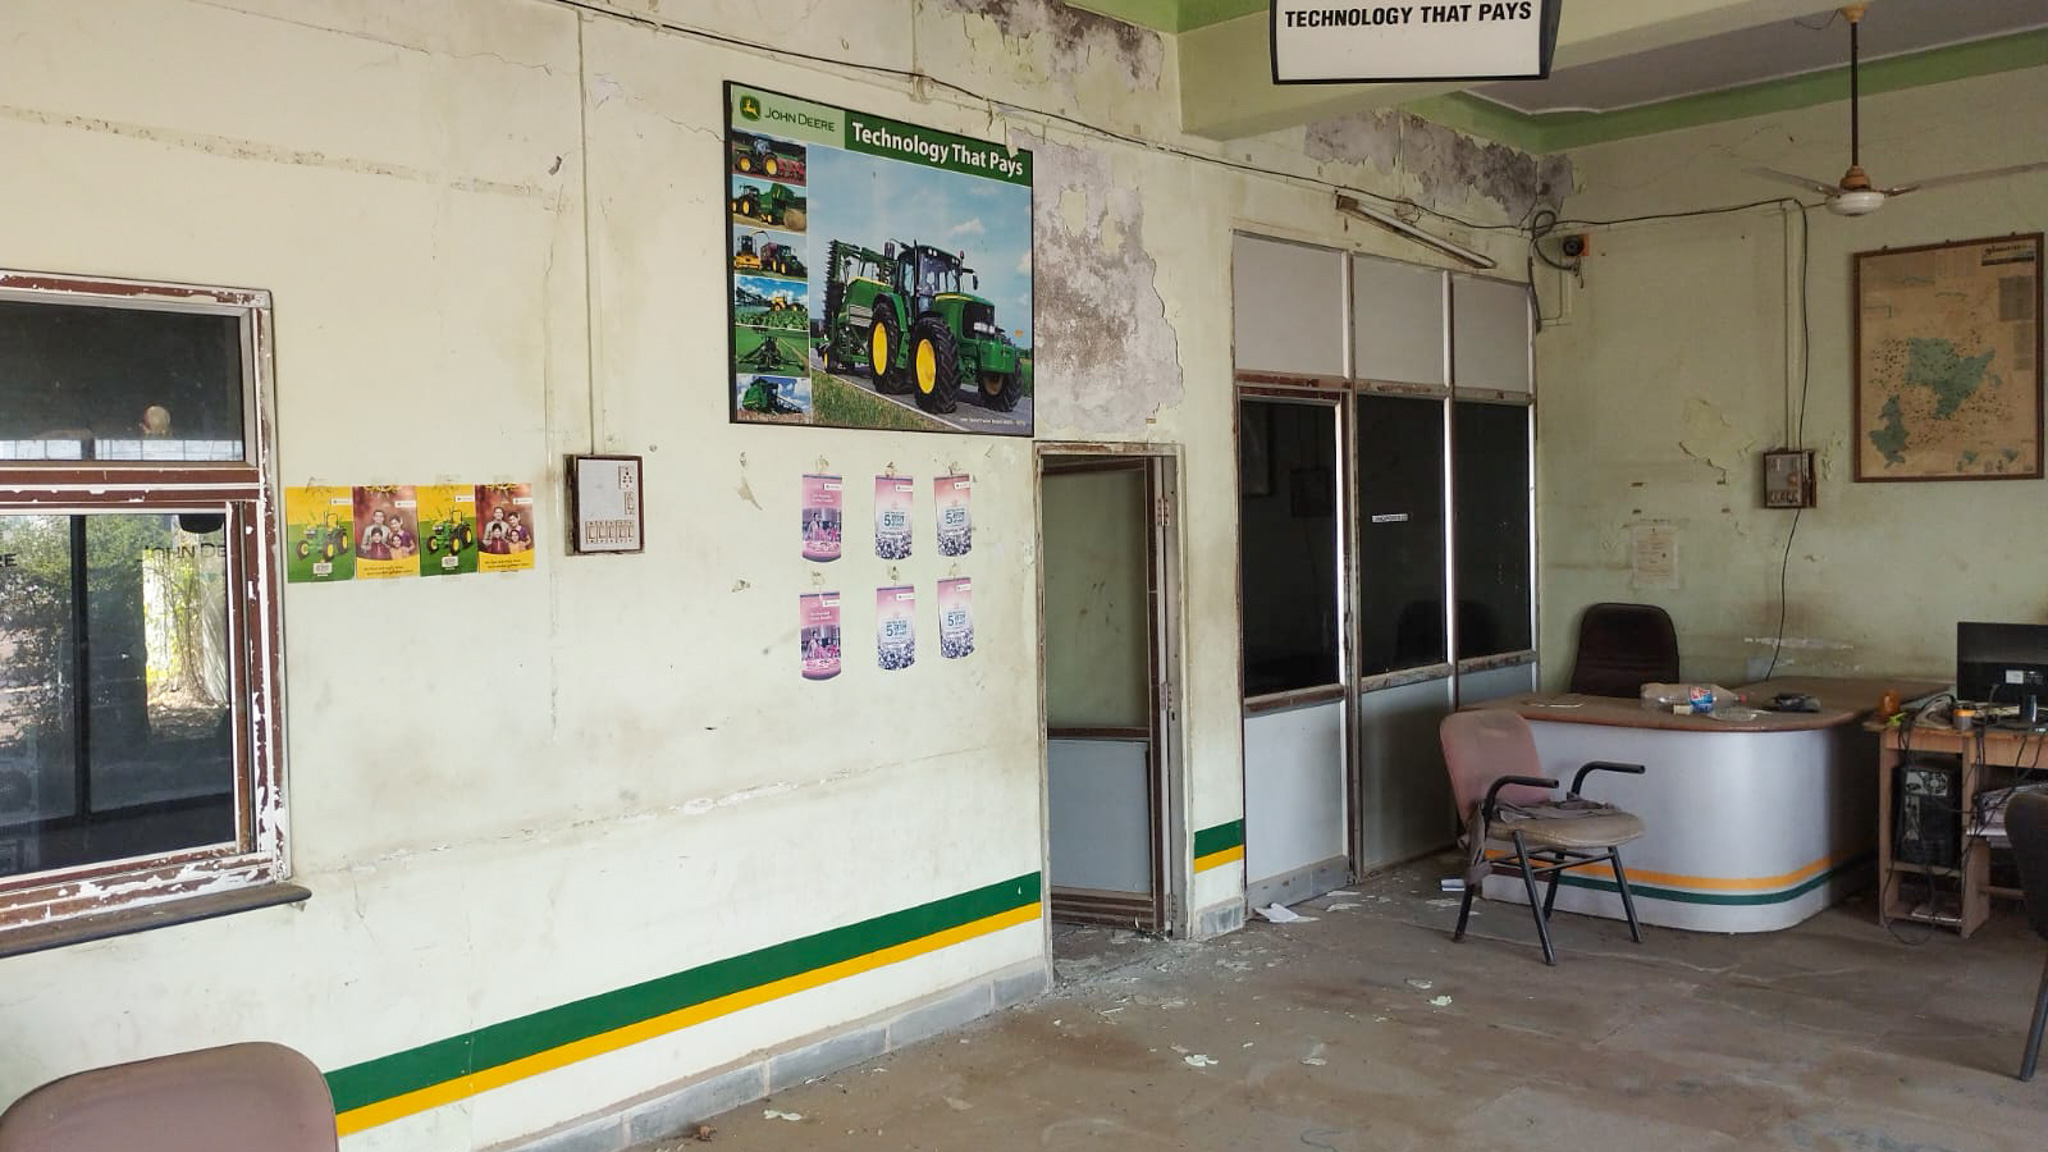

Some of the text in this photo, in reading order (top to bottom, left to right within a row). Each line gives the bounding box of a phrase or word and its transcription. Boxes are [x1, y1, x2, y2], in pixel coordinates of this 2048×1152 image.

[1285, 1, 1532, 28] TECHNOLOGY THAT PAYS
[764, 108, 835, 132] JOHN DEERE
[852, 121, 1023, 177] Technology That Pays
